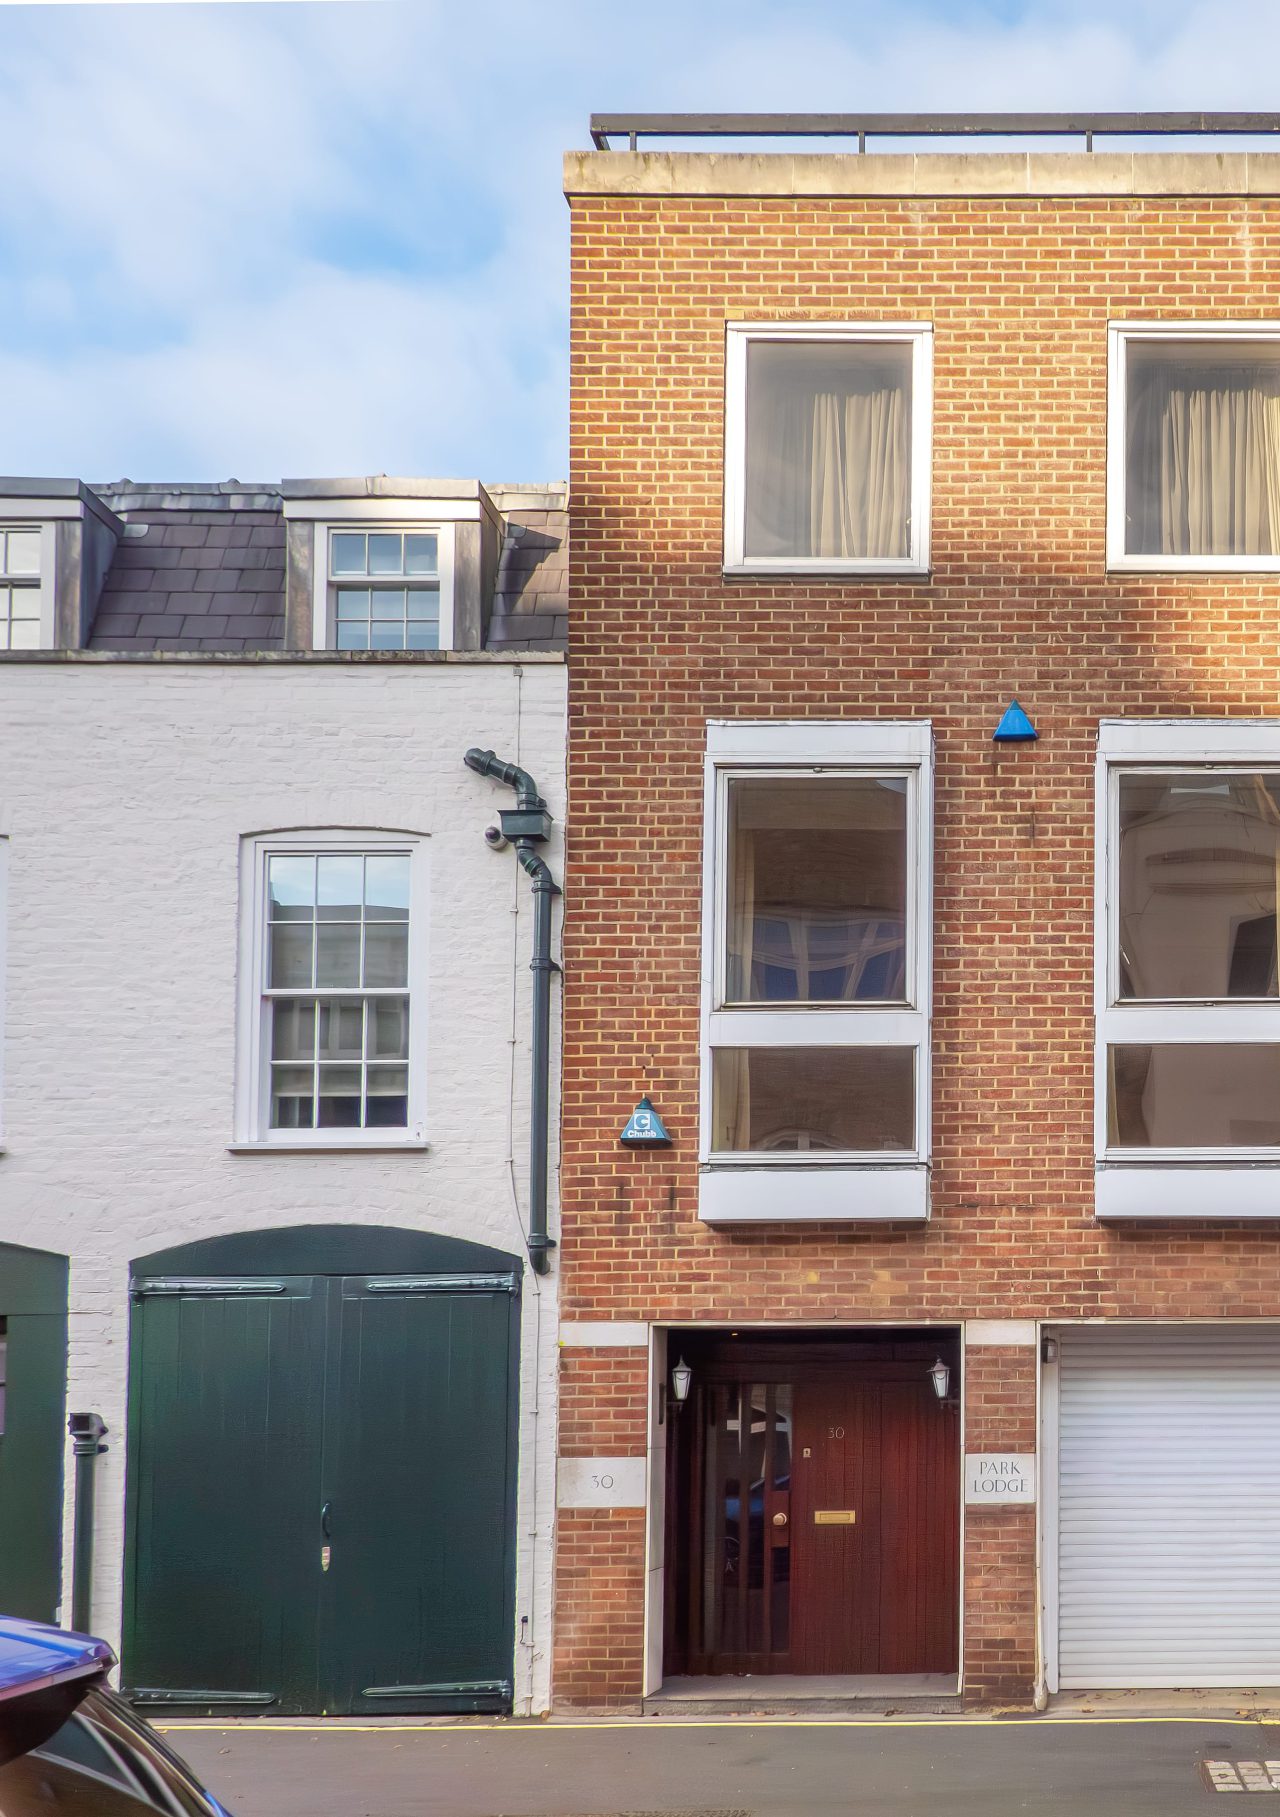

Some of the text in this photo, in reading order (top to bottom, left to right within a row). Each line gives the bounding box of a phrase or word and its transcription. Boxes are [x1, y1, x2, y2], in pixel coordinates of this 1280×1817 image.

[627, 1129, 657, 1138] Chubb
[827, 1426, 845, 1439] 30
[980, 1461, 1020, 1475] PARK
[591, 1474, 614, 1489] 30
[974, 1479, 1029, 1493] LODGE
